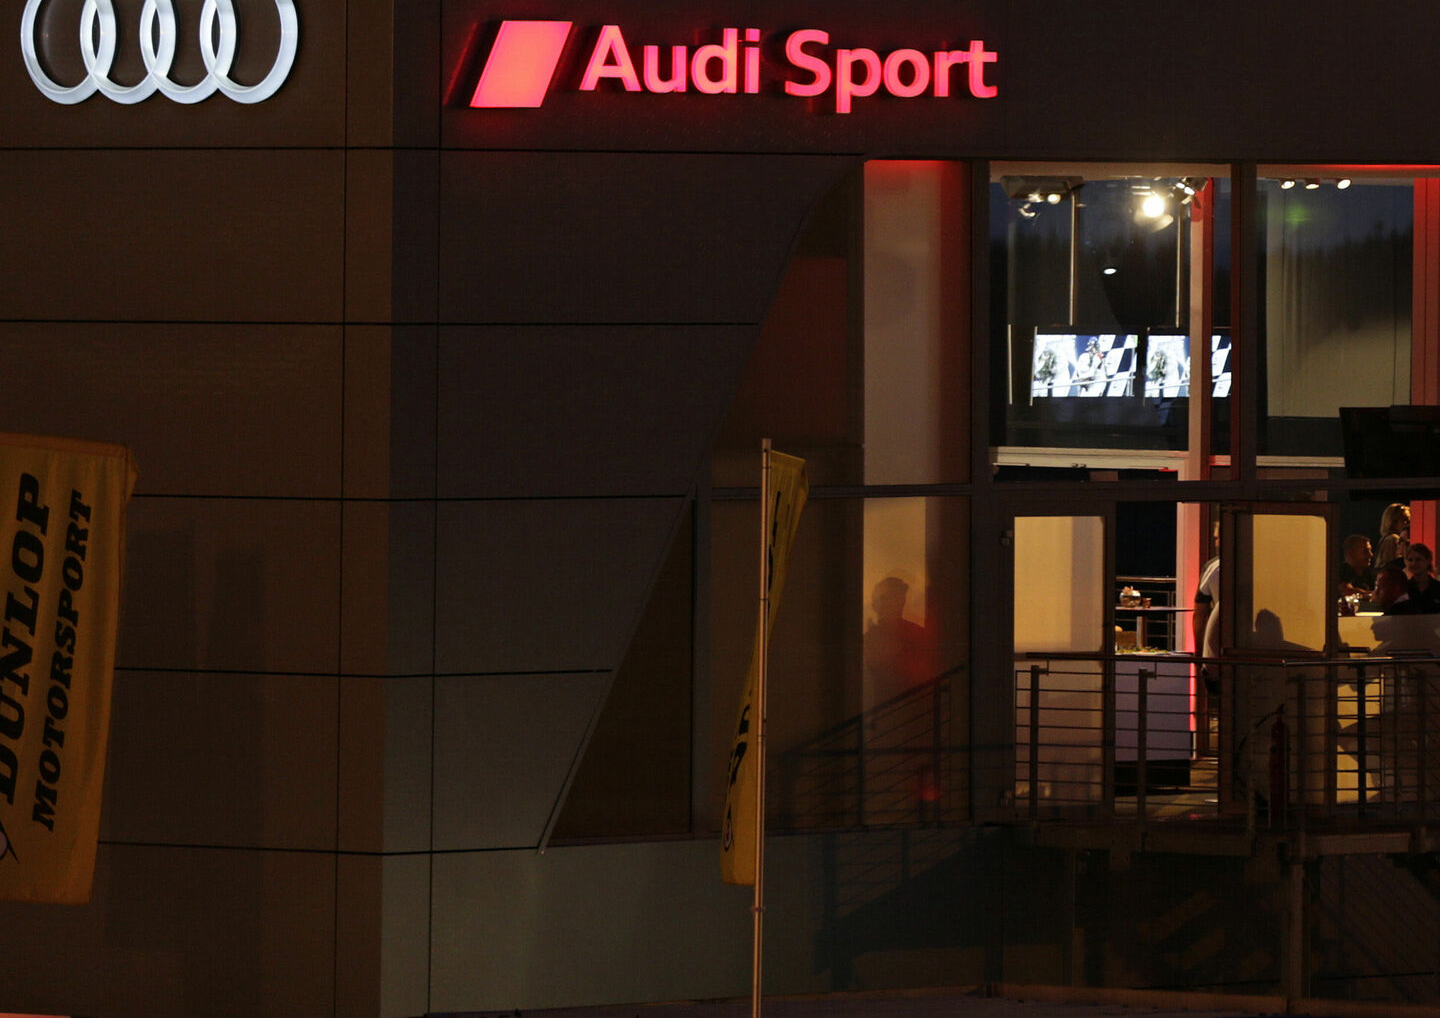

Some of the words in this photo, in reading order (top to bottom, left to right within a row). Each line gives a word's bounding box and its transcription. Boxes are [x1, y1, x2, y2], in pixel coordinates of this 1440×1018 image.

[579, 24, 760, 94] Audi
[783, 29, 998, 114] Sport
[32, 489, 92, 832] MOTORSPORT
